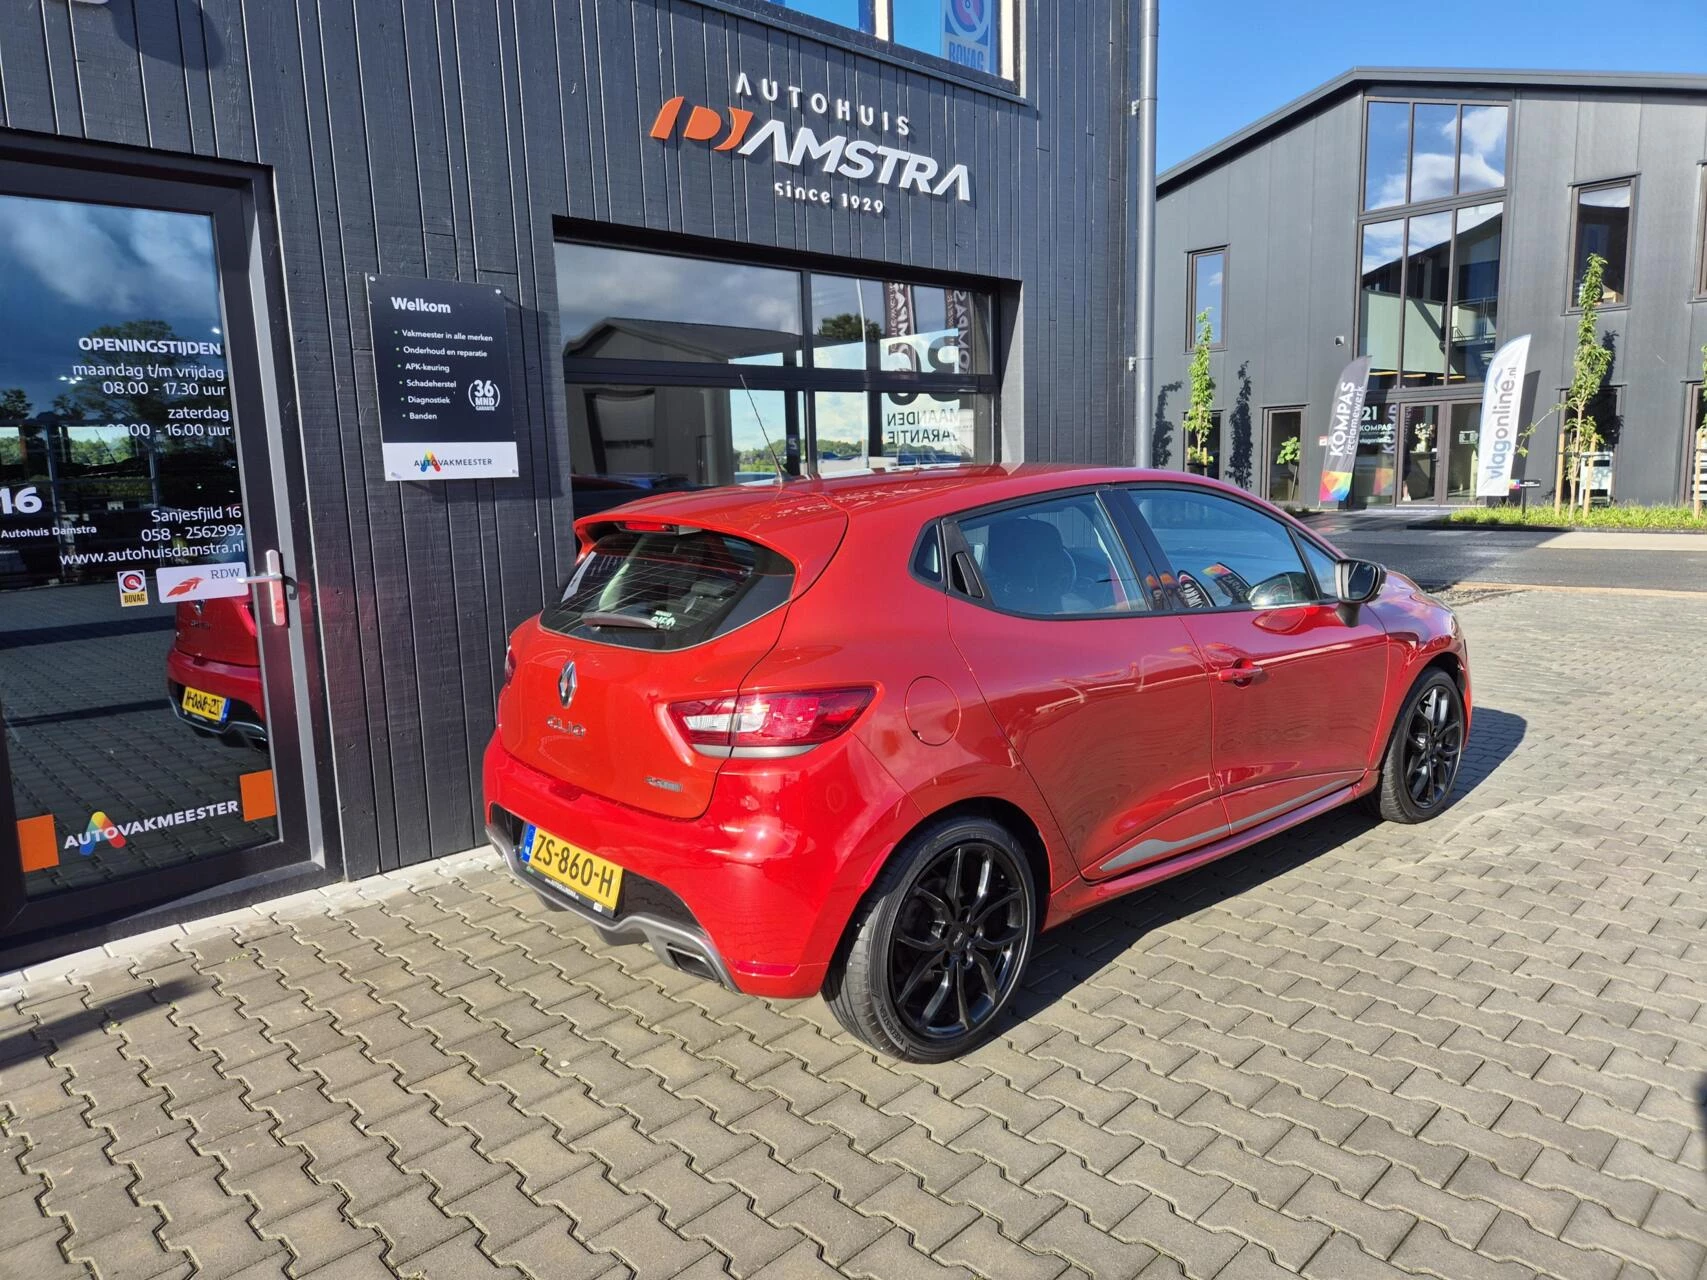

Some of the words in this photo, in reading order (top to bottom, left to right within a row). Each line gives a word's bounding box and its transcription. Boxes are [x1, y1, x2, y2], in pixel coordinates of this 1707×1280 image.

[735, 72, 910, 136] AUTOHUIS
[774, 180, 830, 204] since
[842, 193, 884, 214] 1929
[391, 297, 451, 313] Welkom
[402, 329, 444, 339] Vakmeester
[467, 334, 493, 342] merken
[78, 337, 222, 356] OPENINGSTIJDEN
[403, 346, 445, 355] Onderhoud
[457, 350, 488, 358] reparatie
[73, 363, 144, 379] maandag
[147, 364, 173, 378] t/m
[176, 365, 224, 382] vrijdag
[405, 363, 450, 374] APK-keuring
[103, 382, 149, 396] 08.00
[163, 382, 200, 396] 17.30
[202, 385, 227, 396] uur
[406, 379, 457, 389] Schadeherstel
[474, 380, 494, 397] 36
[408, 396, 451, 405] Diagnostiek
[475, 397, 495, 406] MND
[168, 407, 229, 422] zaterdag
[409, 412, 437, 421] Banden
[1329, 382, 1355, 456] KOMPAS
[1361, 406, 1378, 420] 21
[165, 423, 204, 436] 16.00
[208, 426, 231, 436] uur
[414, 458, 493, 467] AUTOVAKMEESTER
[0, 487, 42, 514] 16
[151, 509, 223, 523] Sanjesfjild
[225, 506, 242, 519] 16
[1, 527, 49, 539] Autohuis
[52, 525, 97, 536] Damstra
[141, 529, 171, 542] 058
[185, 524, 244, 540] 2562992
[59, 540, 245, 565] www.autohuisdamstra.nl
[210, 568, 240, 580] RDW
[124, 593, 145, 604] BOVAG
[64, 800, 239, 849] AUTOVAKMEESTER
[534, 834, 614, 898] ZS-860-H
